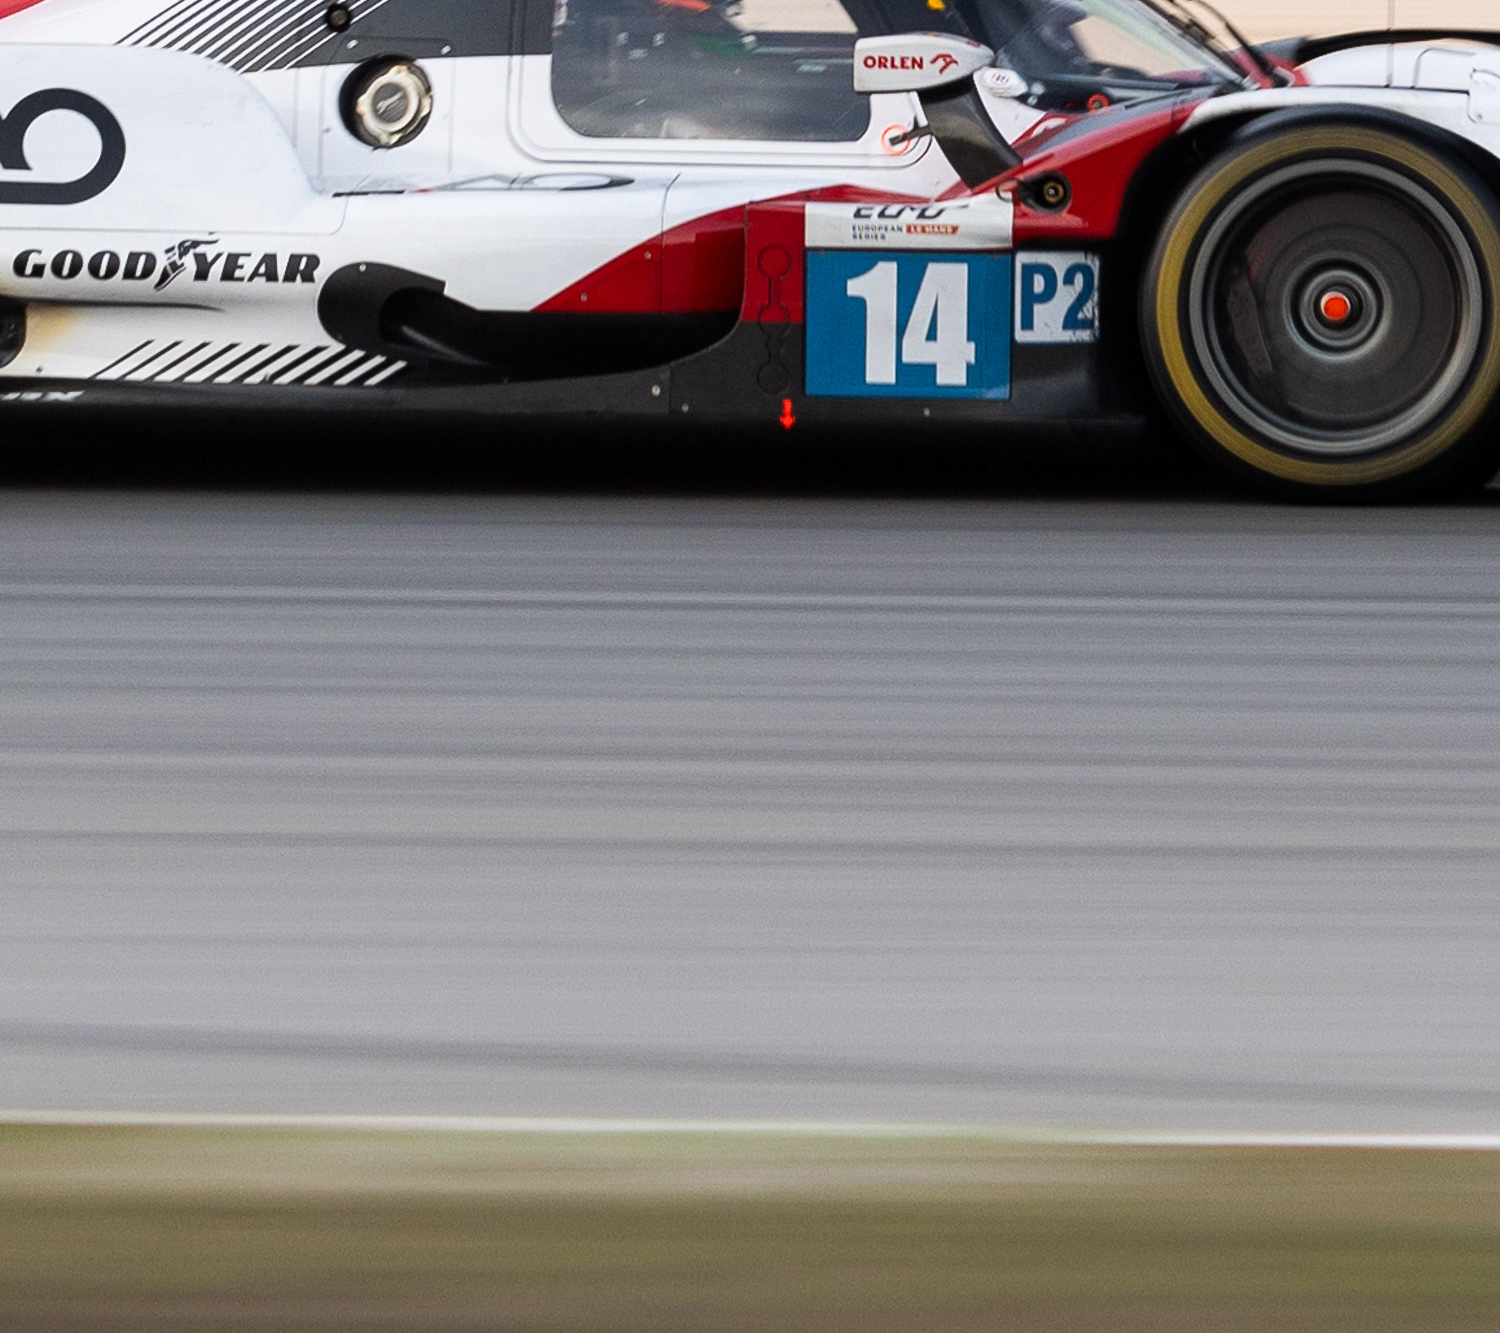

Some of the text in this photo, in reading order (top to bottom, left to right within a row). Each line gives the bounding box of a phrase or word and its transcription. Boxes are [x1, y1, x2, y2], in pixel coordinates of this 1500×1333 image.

[863, 55, 924, 70] ORLEN
[847, 261, 975, 386] 14
[1020, 262, 1096, 331] P2
